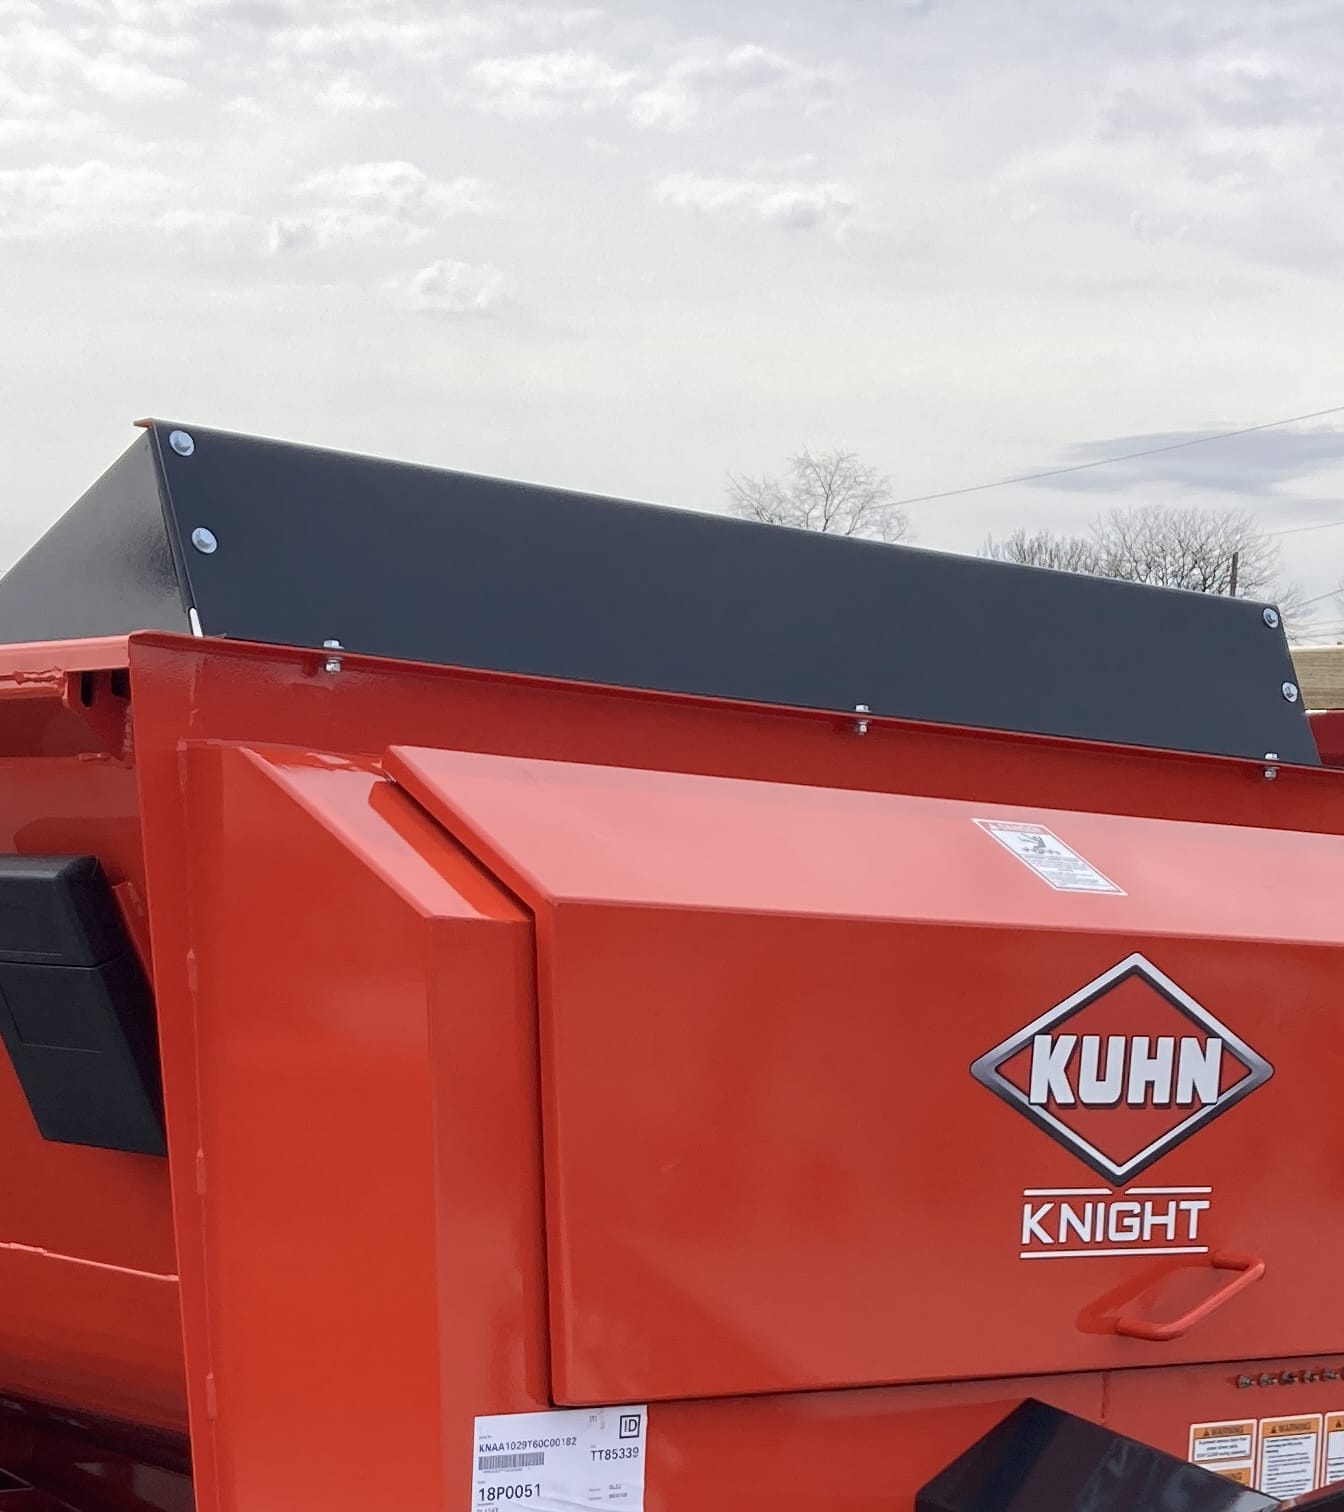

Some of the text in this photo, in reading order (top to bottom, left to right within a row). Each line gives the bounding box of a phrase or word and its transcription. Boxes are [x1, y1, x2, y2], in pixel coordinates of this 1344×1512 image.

[1029, 1033, 1224, 1107] KUHN
[1020, 1200, 1211, 1245] KNIGHT
[623, 1418, 638, 1433] ID
[590, 1446, 640, 1462] TT85339
[478, 1483, 541, 1502] 18P0051
